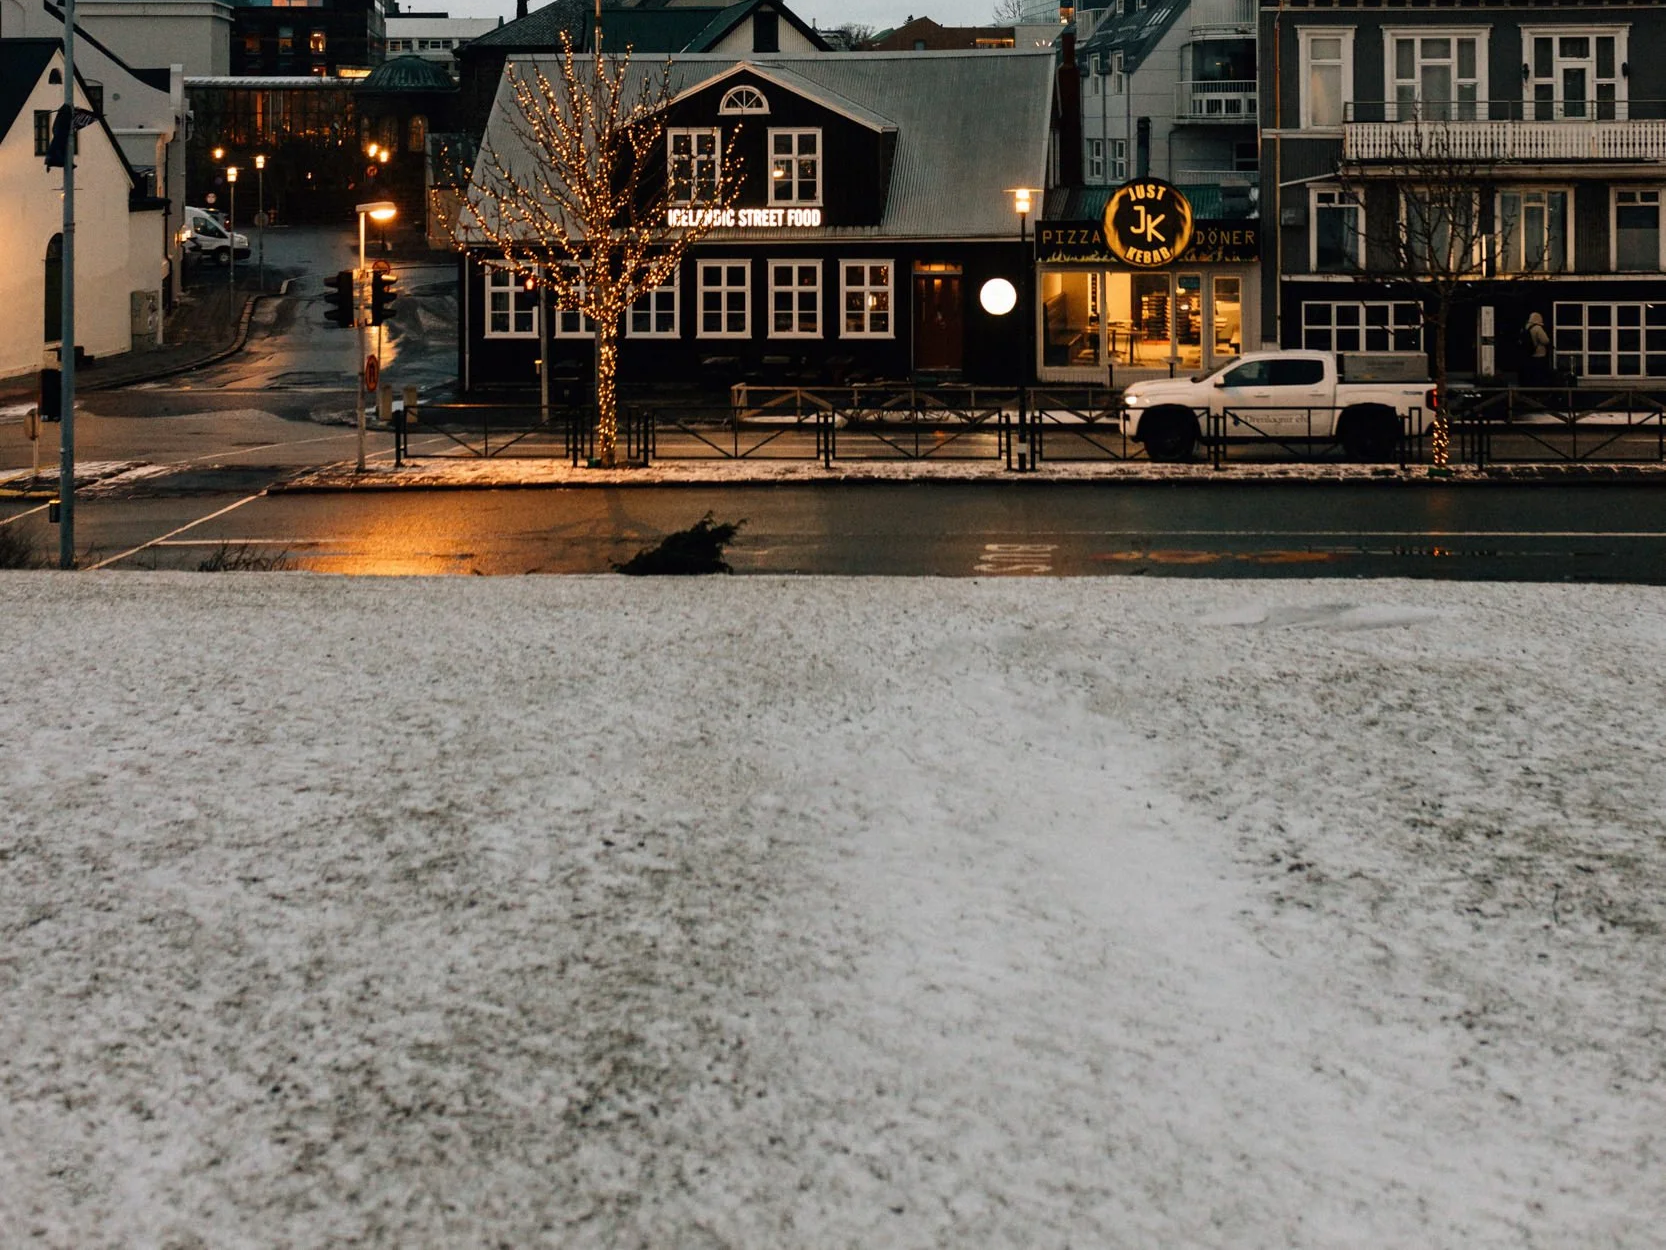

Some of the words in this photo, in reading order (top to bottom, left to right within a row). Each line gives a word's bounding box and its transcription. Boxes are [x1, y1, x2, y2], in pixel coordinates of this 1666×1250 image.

[1128, 184, 1166, 201] JUST
[668, 209, 735, 227] ICELANDIC
[738, 209, 785, 227] STREET
[787, 209, 821, 227] FOOD
[1130, 205, 1166, 242] JK
[1042, 230, 1101, 244] PIZZA
[1196, 228, 1255, 244] DÖNER
[1125, 246, 1172, 264] KEBAB
